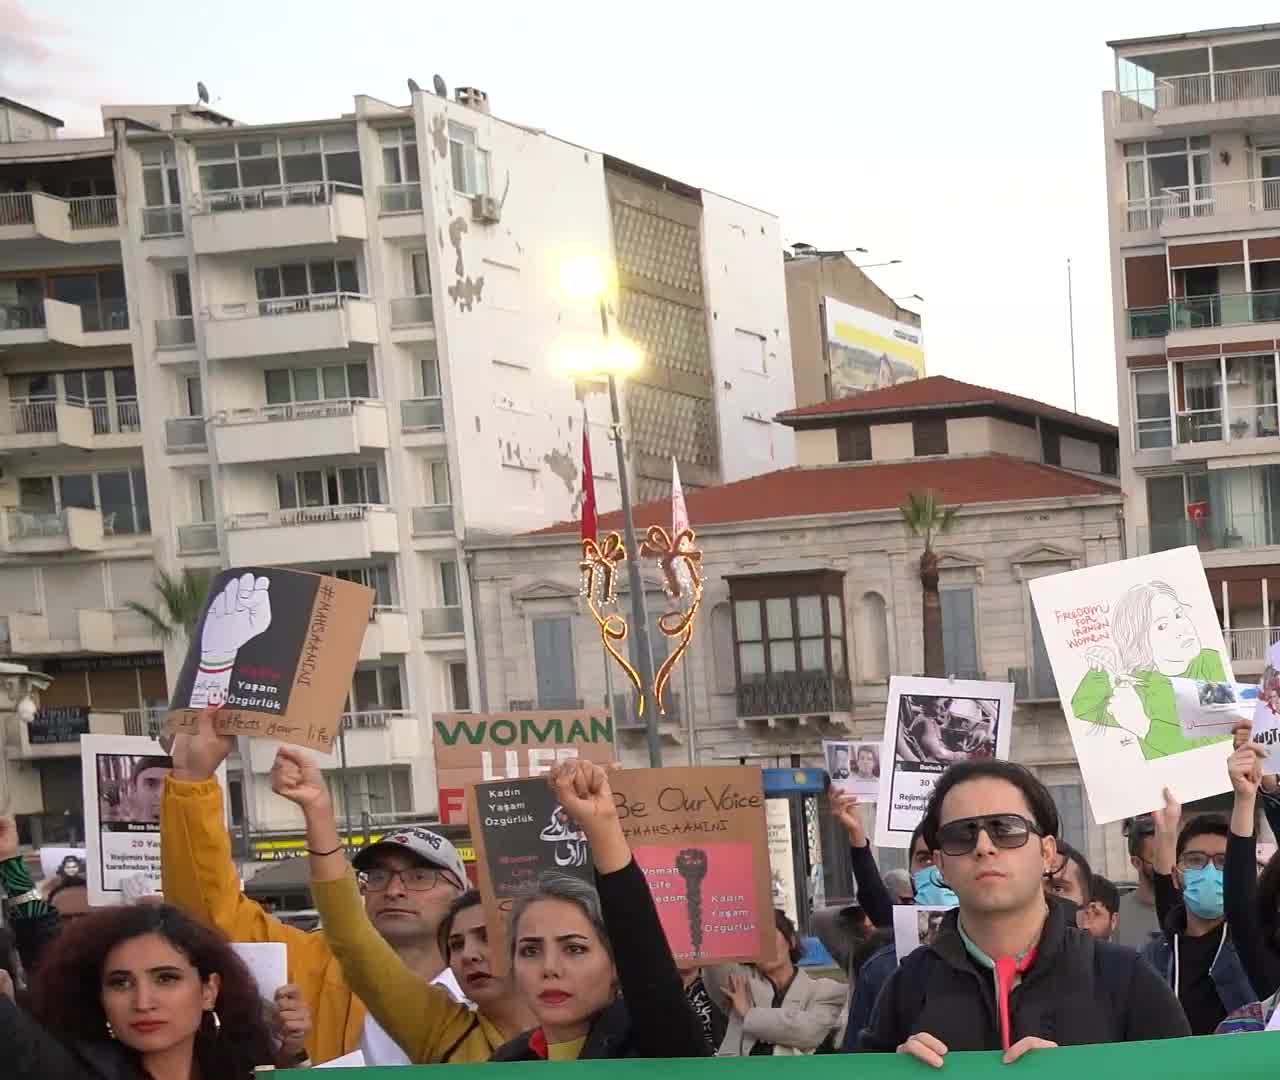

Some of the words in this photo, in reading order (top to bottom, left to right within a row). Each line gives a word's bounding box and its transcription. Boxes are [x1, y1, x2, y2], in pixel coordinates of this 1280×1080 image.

[237, 680, 278, 693] Yaşam
[434, 717, 614, 746] WOMAN
[919, 779, 930, 787] 30
[488, 788, 521, 799] Kadın
[488, 802, 526, 812] Yaşam
[611, 792, 648, 819] Be
[657, 787, 706, 812] Our
[704, 783, 763, 812] Voice
